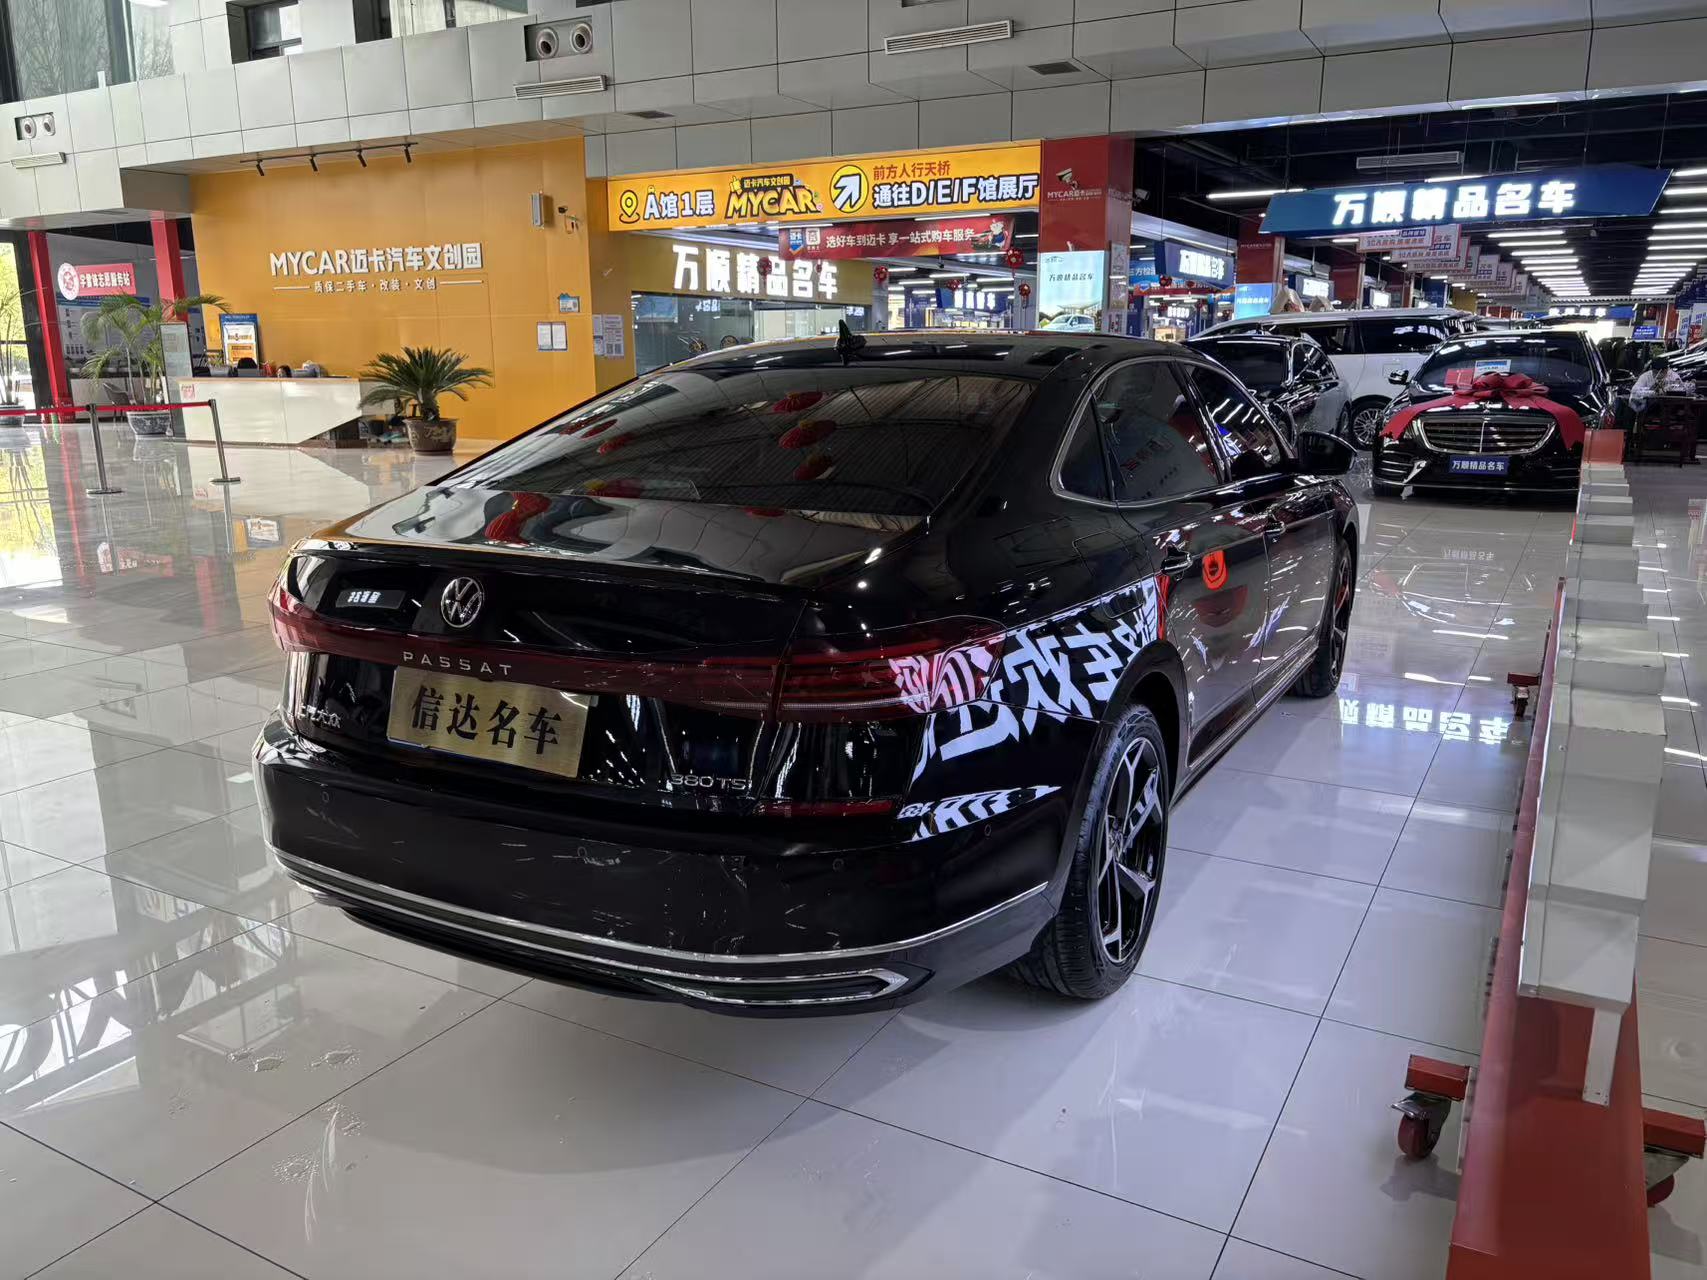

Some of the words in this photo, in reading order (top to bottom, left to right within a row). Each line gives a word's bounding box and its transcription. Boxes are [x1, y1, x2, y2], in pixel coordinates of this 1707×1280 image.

[873, 160, 950, 180] 前方人行天桥
[643, 190, 714, 220] A馆1层
[726, 187, 818, 218] MYCAR
[874, 175, 1039, 208] 通往D/E/F馆展厅
[1332, 181, 1576, 225] 万顺精品名车
[826, 233, 886, 249] 选好车到迈卡
[888, 229, 975, 246] 享一站式购车服务
[270, 242, 483, 276] MYCAR迈卡汽车文创园
[672, 244, 838, 300] 万顺精品名车
[1452, 460, 1505, 471] 万顺精品名车
[403, 651, 512, 676] PASSAT
[411, 684, 563, 755] 信达名车
